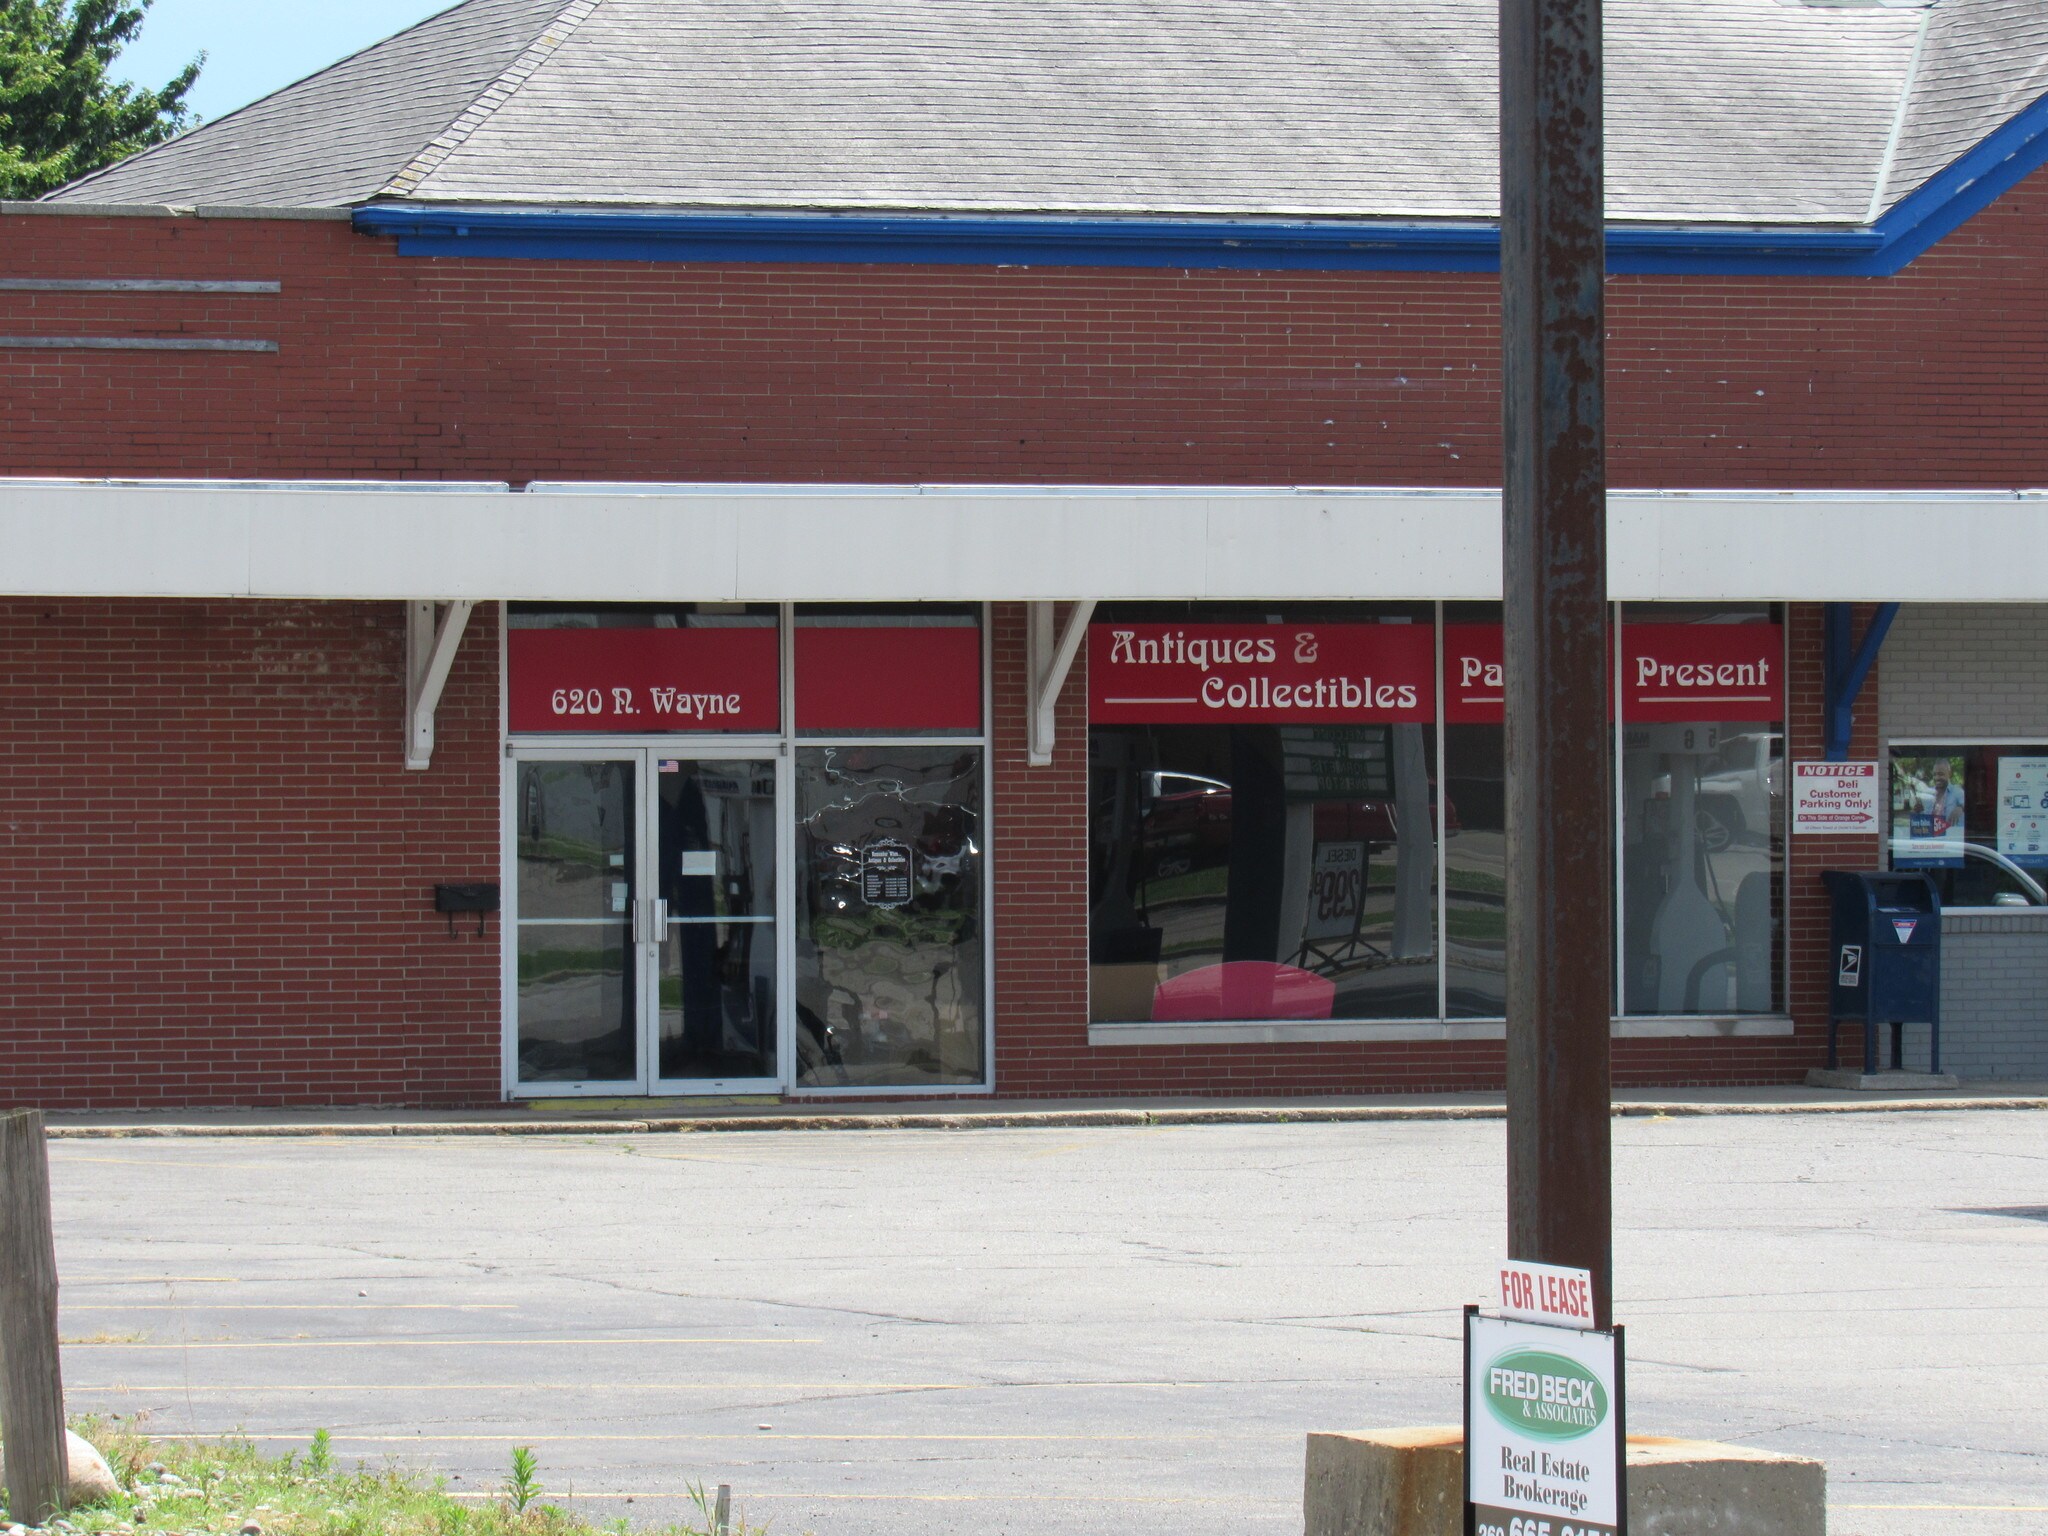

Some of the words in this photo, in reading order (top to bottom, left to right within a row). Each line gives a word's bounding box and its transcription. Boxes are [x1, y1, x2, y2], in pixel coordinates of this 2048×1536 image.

[1110, 630, 1276, 671] Antiques
[1294, 632, 1318, 664] &
[1460, 657, 1504, 687] Pa
[1636, 657, 1769, 687] Present
[552, 688, 603, 715] 620
[650, 687, 741, 720] Wayne
[1201, 677, 1418, 708] Collectibles
[1803, 766, 1866, 776] NOTICE
[1838, 780, 1858, 788] Deli
[1800, 800, 1841, 809] Parking
[1845, 800, 1872, 809] Only!
[1810, 790, 1861, 798] Customer
[1500, 1270, 1534, 1310] FOR
[1538, 1275, 1589, 1318] LEASE
[1490, 1367, 1540, 1400] FRED
[1541, 1374, 1595, 1408] BECK
[1522, 1399, 1531, 1417] &
[1534, 1403, 1597, 1427] ASSOCIATES
[1501, 1446, 1536, 1474] Real
[1541, 1452, 1590, 1482] Estate
[1503, 1474, 1588, 1515] Brokerage
